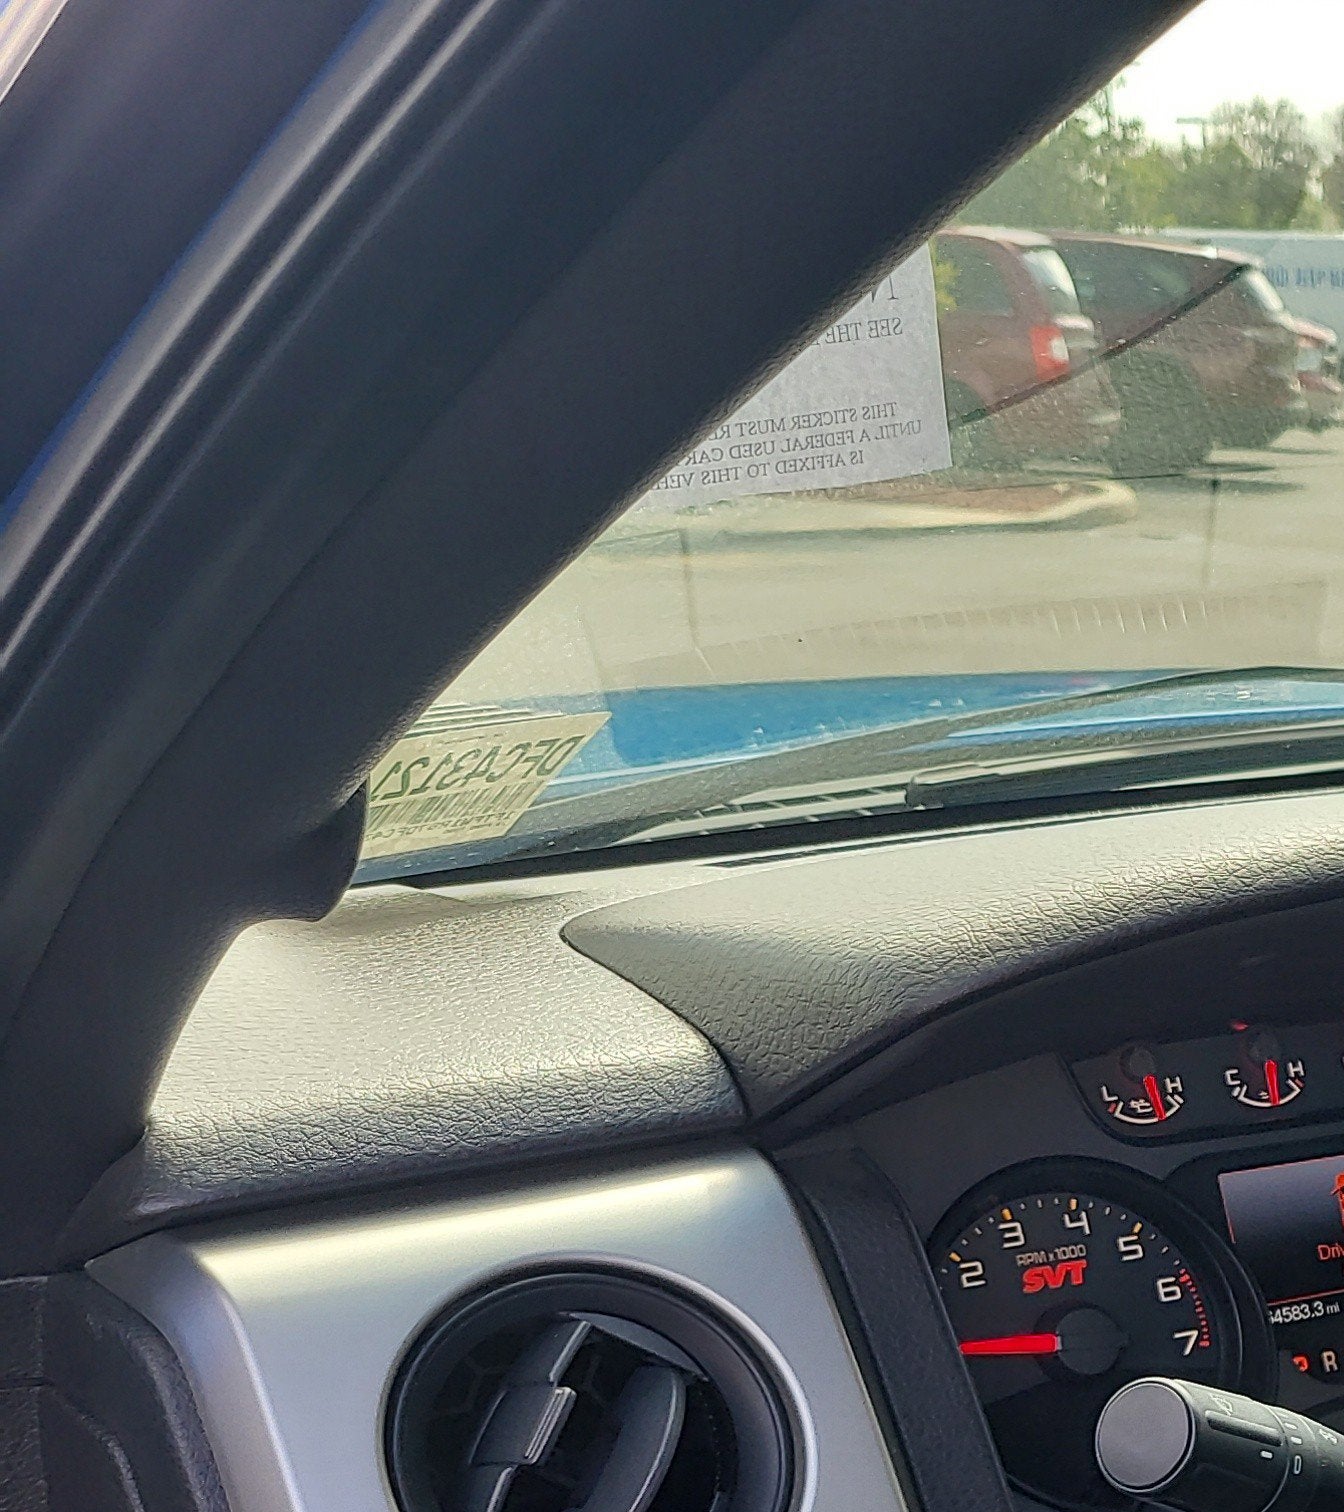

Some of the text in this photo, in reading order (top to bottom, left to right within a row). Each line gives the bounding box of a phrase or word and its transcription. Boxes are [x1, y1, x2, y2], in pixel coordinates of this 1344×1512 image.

[1224, 1068, 1241, 1085] C
[1287, 1059, 1304, 1077] H
[1101, 1085, 1119, 1101] L
[1165, 1076, 1183, 1093] H
[997, 1221, 1026, 1249] 3
[1063, 1210, 1092, 1236] 4
[1016, 1251, 1047, 1267] RPM
[1117, 1234, 1144, 1262] 5
[959, 1260, 987, 1288] 2
[1022, 1259, 1088, 1294] SVT
[1156, 1276, 1182, 1303] 6
[1326, 1302, 1340, 1315] mi
[1173, 1329, 1199, 1356] 7
[1322, 1351, 1339, 1373] R
